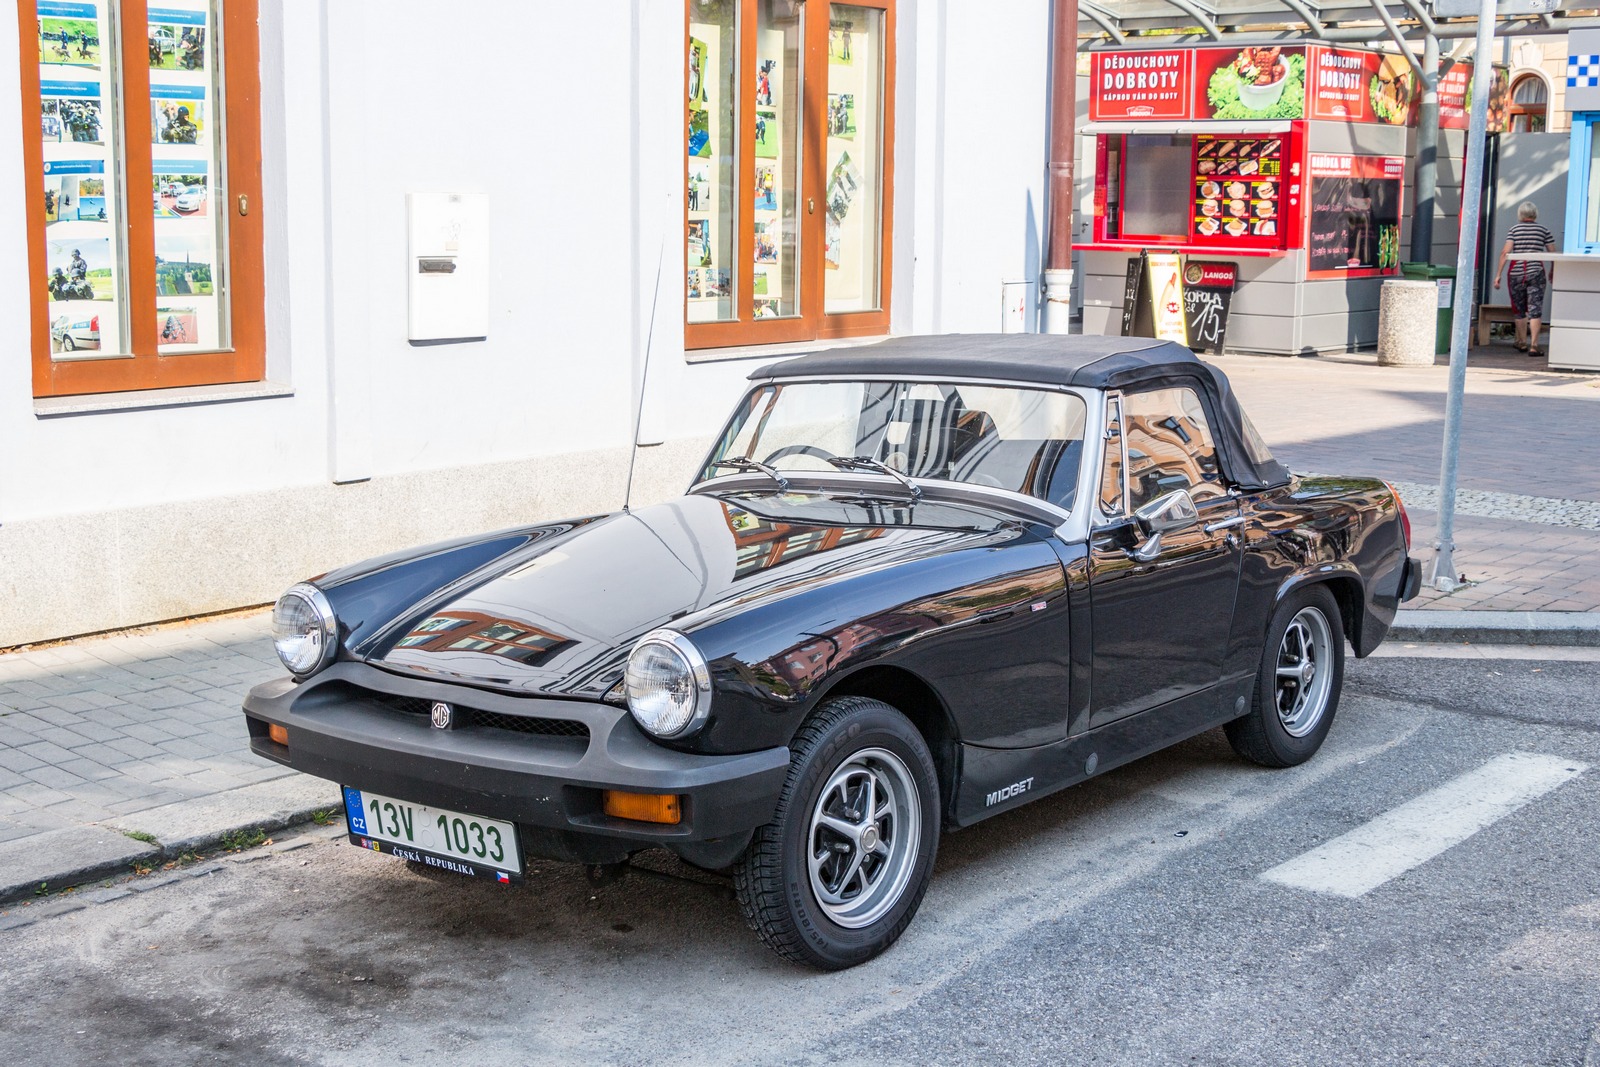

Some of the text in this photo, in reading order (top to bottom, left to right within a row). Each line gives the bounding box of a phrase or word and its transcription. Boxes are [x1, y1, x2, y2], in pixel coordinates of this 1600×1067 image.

[1104, 55, 1179, 69] DĚDOUCHOVY
[1104, 71, 1178, 89] DOBROTY
[1320, 70, 1360, 89] DOBROTY
[1148, 92, 1158, 100] DO
[1204, 271, 1234, 280] LANGOŠ
[433, 705, 447, 726] MG
[986, 776, 1034, 807] MIDGET
[352, 817, 365, 829] CZ
[370, 799, 504, 862] 13V 1033
[393, 846, 475, 876] ČESKÁ REPUBLIKA
